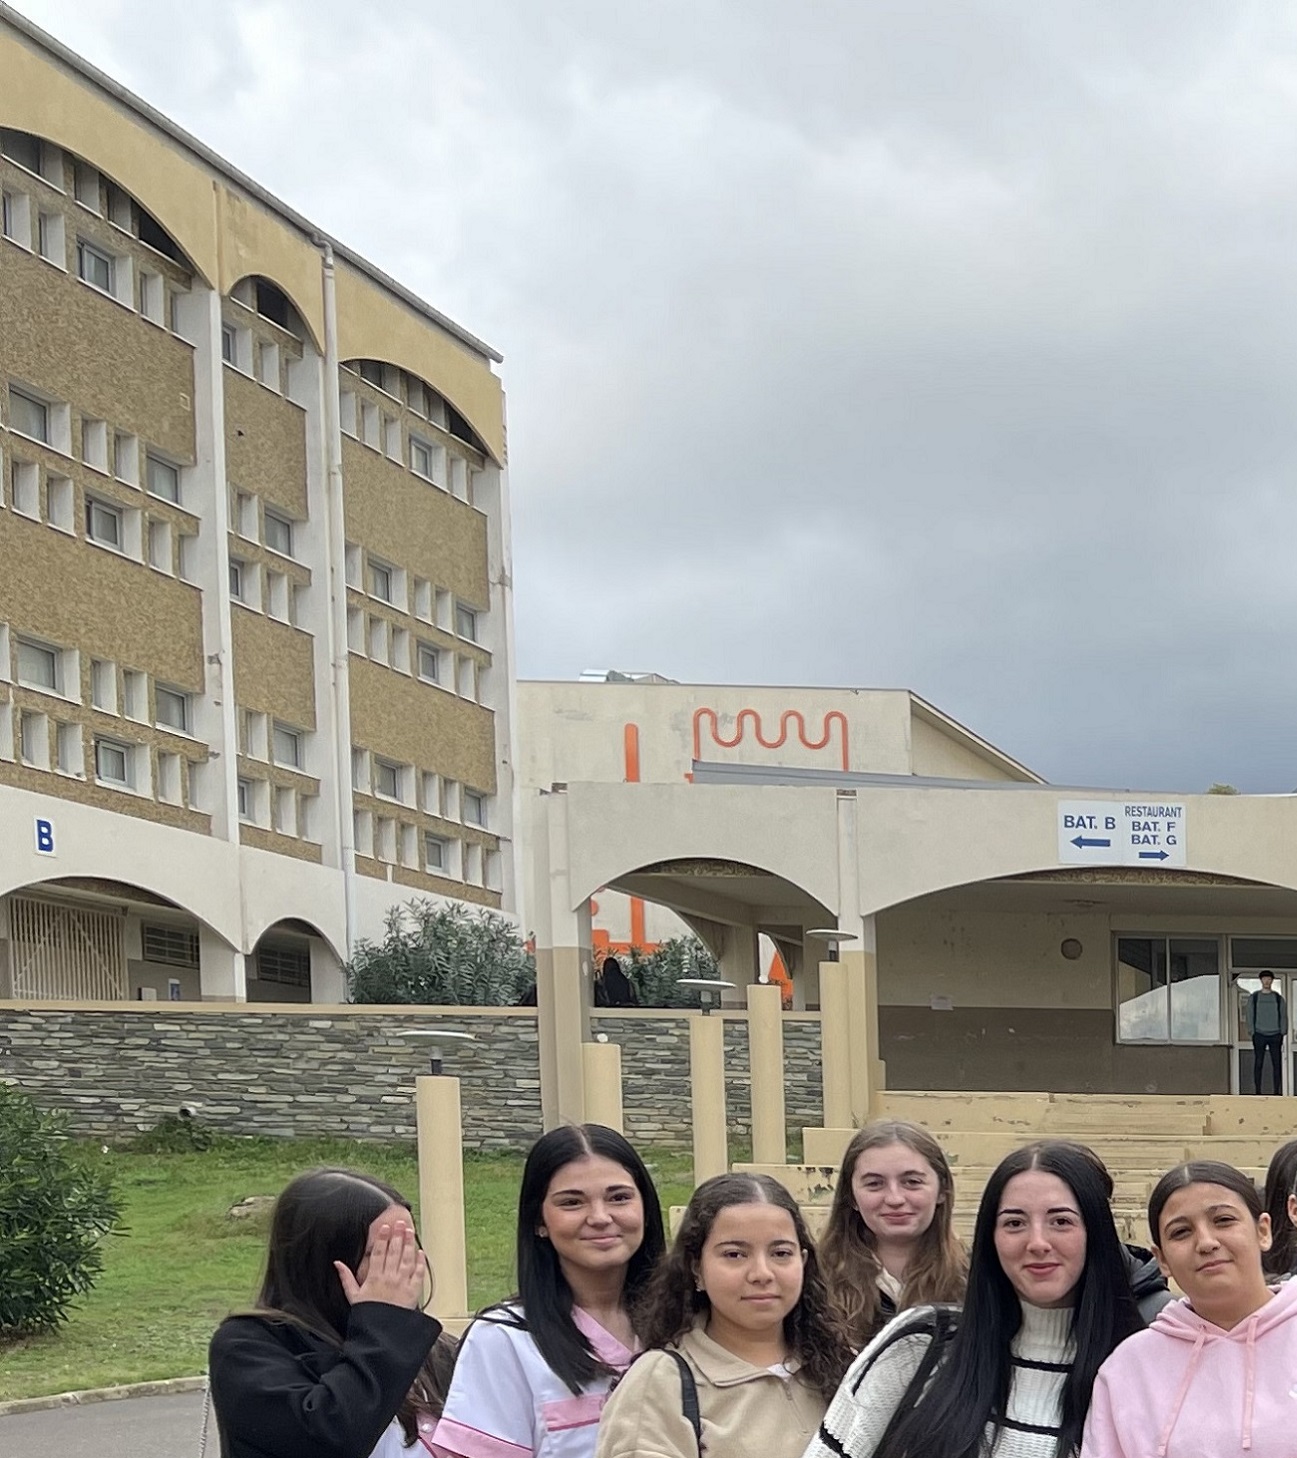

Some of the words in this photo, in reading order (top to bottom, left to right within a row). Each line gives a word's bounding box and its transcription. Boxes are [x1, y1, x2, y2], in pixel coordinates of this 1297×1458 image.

[1124, 805, 1183, 818] RESTAURANT
[1063, 815, 1098, 829] BAT.
[1104, 816, 1116, 830] B
[1131, 821, 1161, 832] BAT.
[1166, 821, 1176, 832] F
[36, 819, 54, 852] B
[1131, 834, 1161, 845] BAT.
[1166, 835, 1177, 846] G
